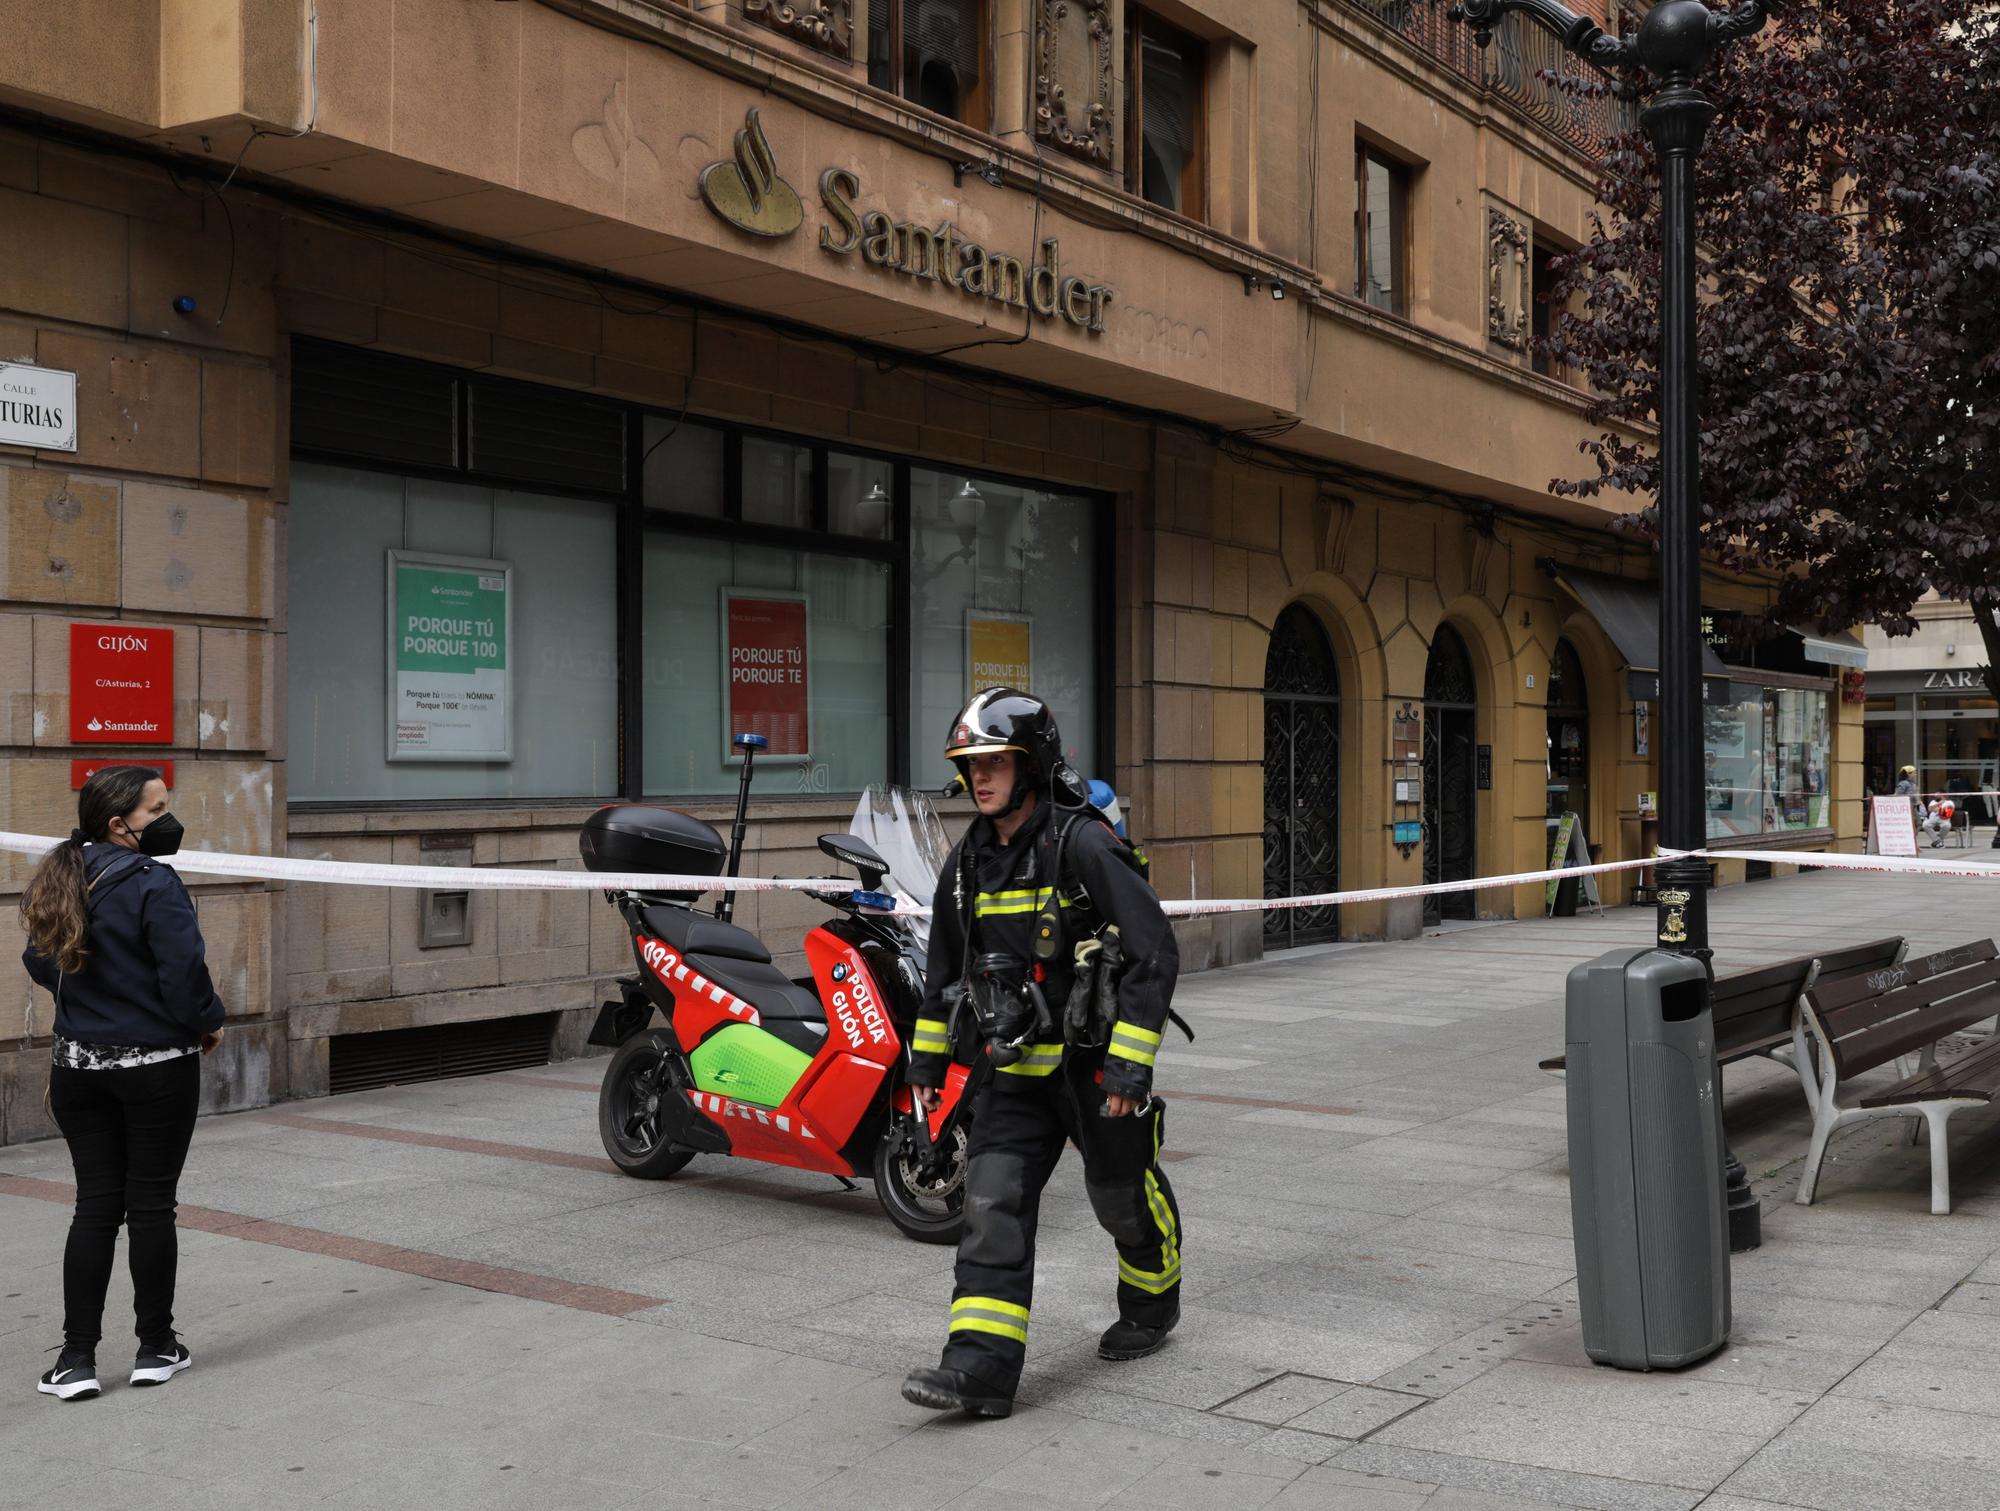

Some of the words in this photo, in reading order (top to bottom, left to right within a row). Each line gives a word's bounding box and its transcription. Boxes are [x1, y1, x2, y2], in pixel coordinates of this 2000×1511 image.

[819, 167, 1113, 337] Santander
[3, 383, 37, 396] CALLE
[0, 400, 63, 429] TURIAS
[408, 615, 472, 637] PORQUE
[475, 618, 494, 637] TÚ
[98, 635, 148, 652] GIJÓN
[404, 636, 468, 656] PORQUE
[472, 640, 497, 657] 100
[732, 647, 784, 664] PORQUE
[786, 646, 801, 664] TÚ
[732, 667, 784, 684] PORQUE
[788, 668, 801, 684] TE
[974, 662, 1014, 677] PORQUE
[1015, 662, 1027, 677] TÚ
[145, 680, 151, 688] 2
[406, 690, 431, 699] Porque
[432, 690, 440, 698] tú
[416, 701, 440, 711] Porque
[104, 720, 158, 731] Santander
[643, 941, 677, 978] 092
[846, 972, 886, 1044] POLICÍA
[832, 991, 865, 1049] GIJÓN
